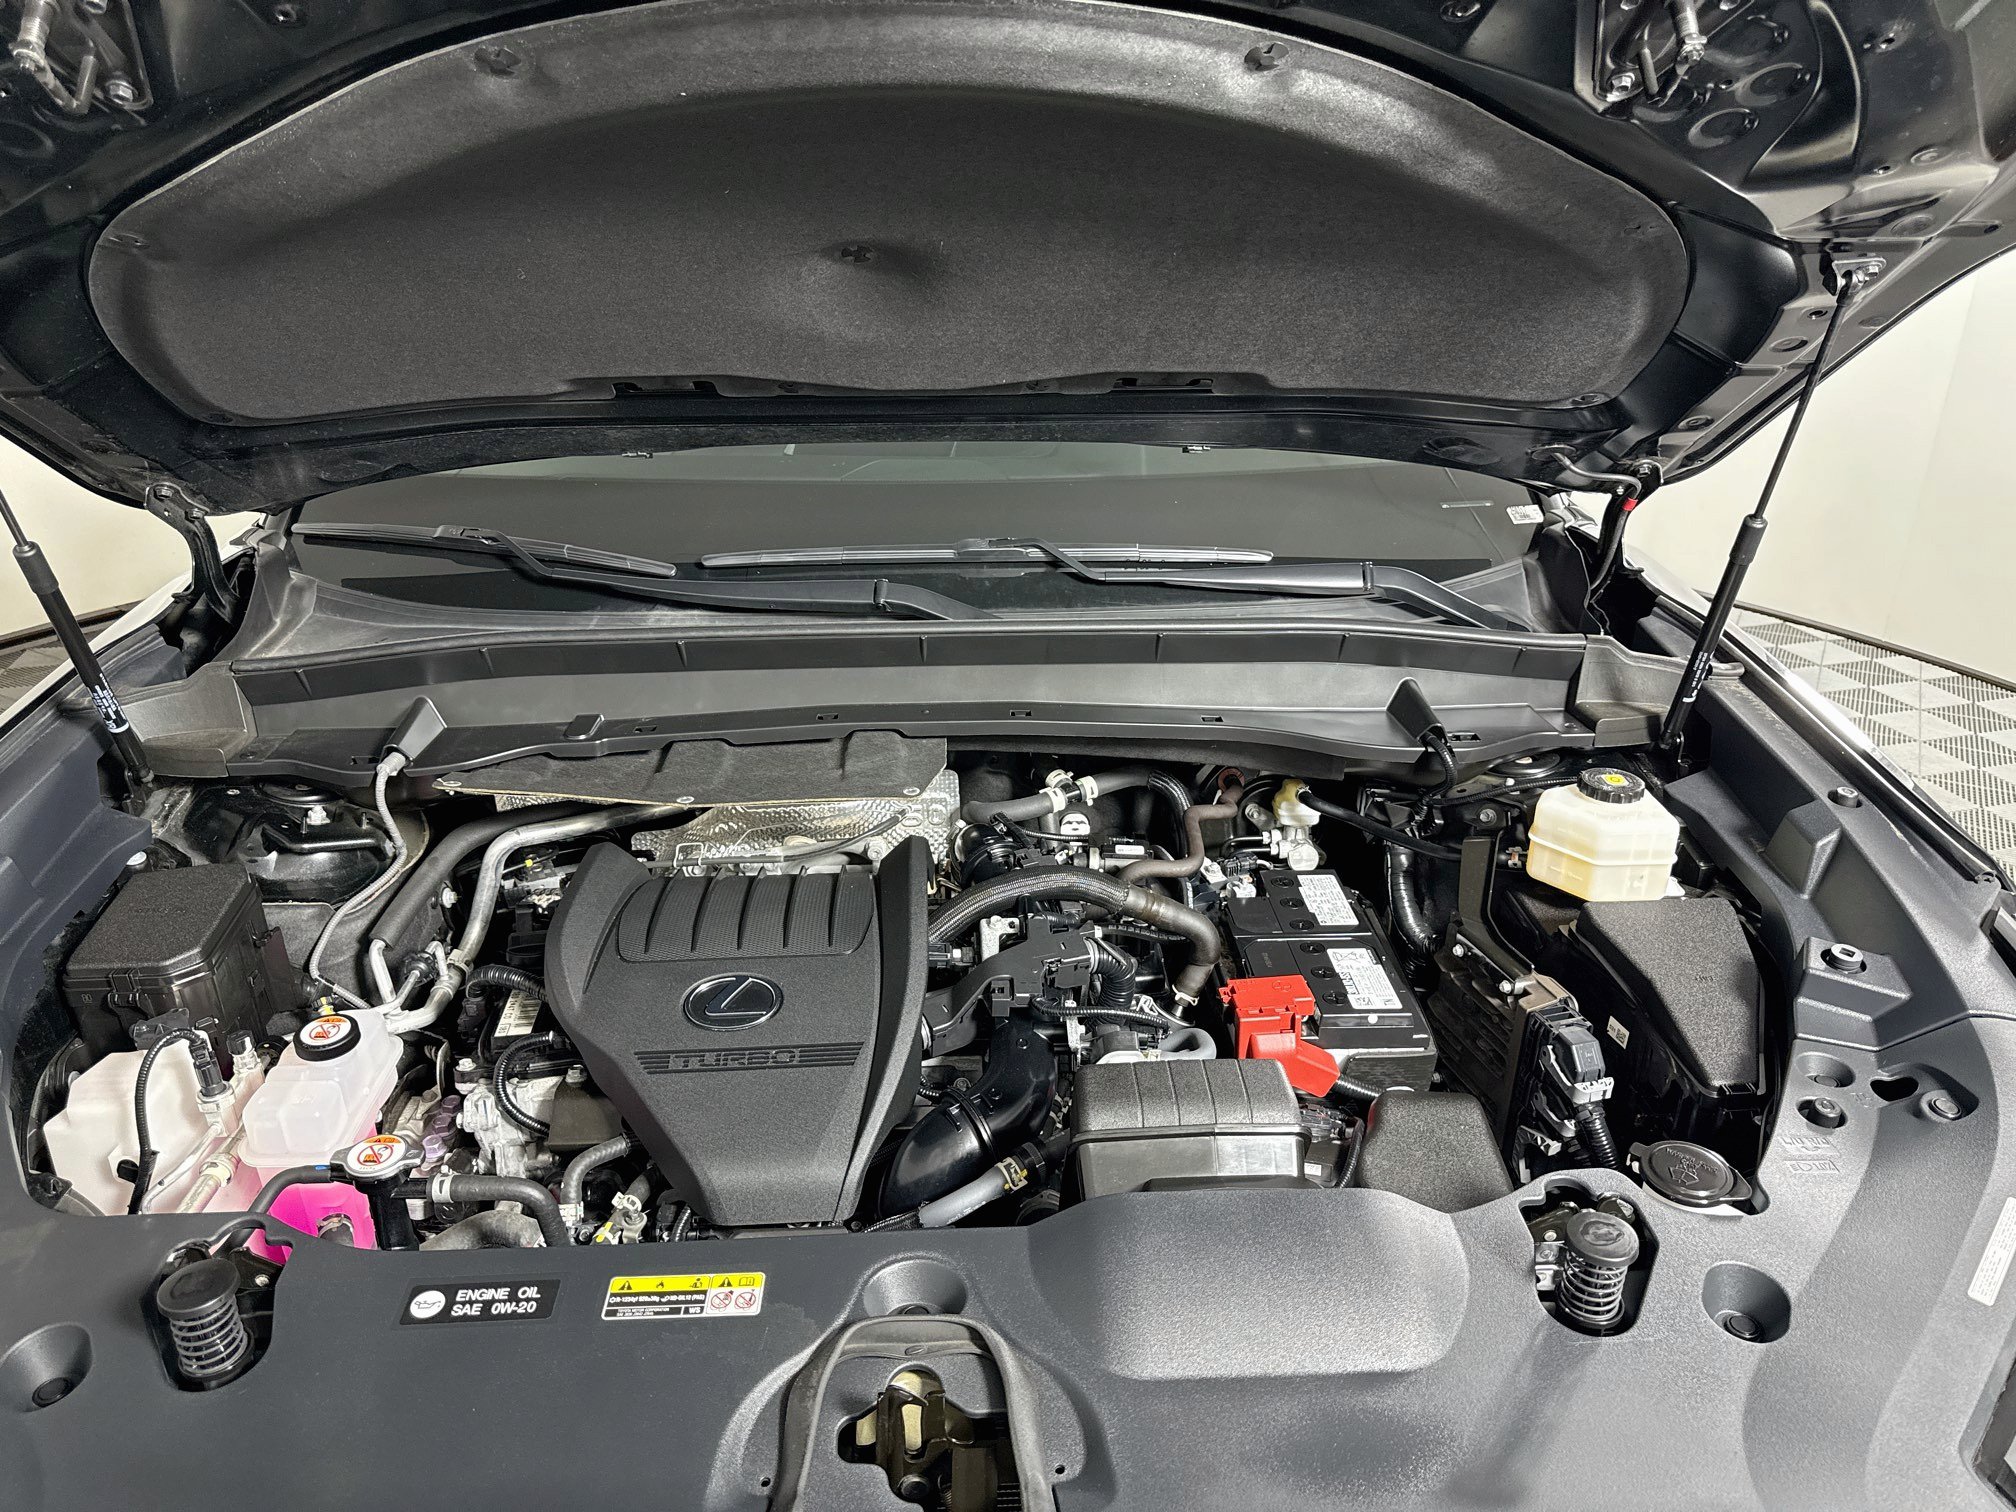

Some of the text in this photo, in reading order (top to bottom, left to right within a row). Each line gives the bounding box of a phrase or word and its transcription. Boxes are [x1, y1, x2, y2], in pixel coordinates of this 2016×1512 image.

[674, 1049, 796, 1068] TURBO
[455, 1286, 541, 1302] ENGINE OIL
[450, 1301, 537, 1317] SAE 0W-20
[689, 1307, 701, 1315] WS
